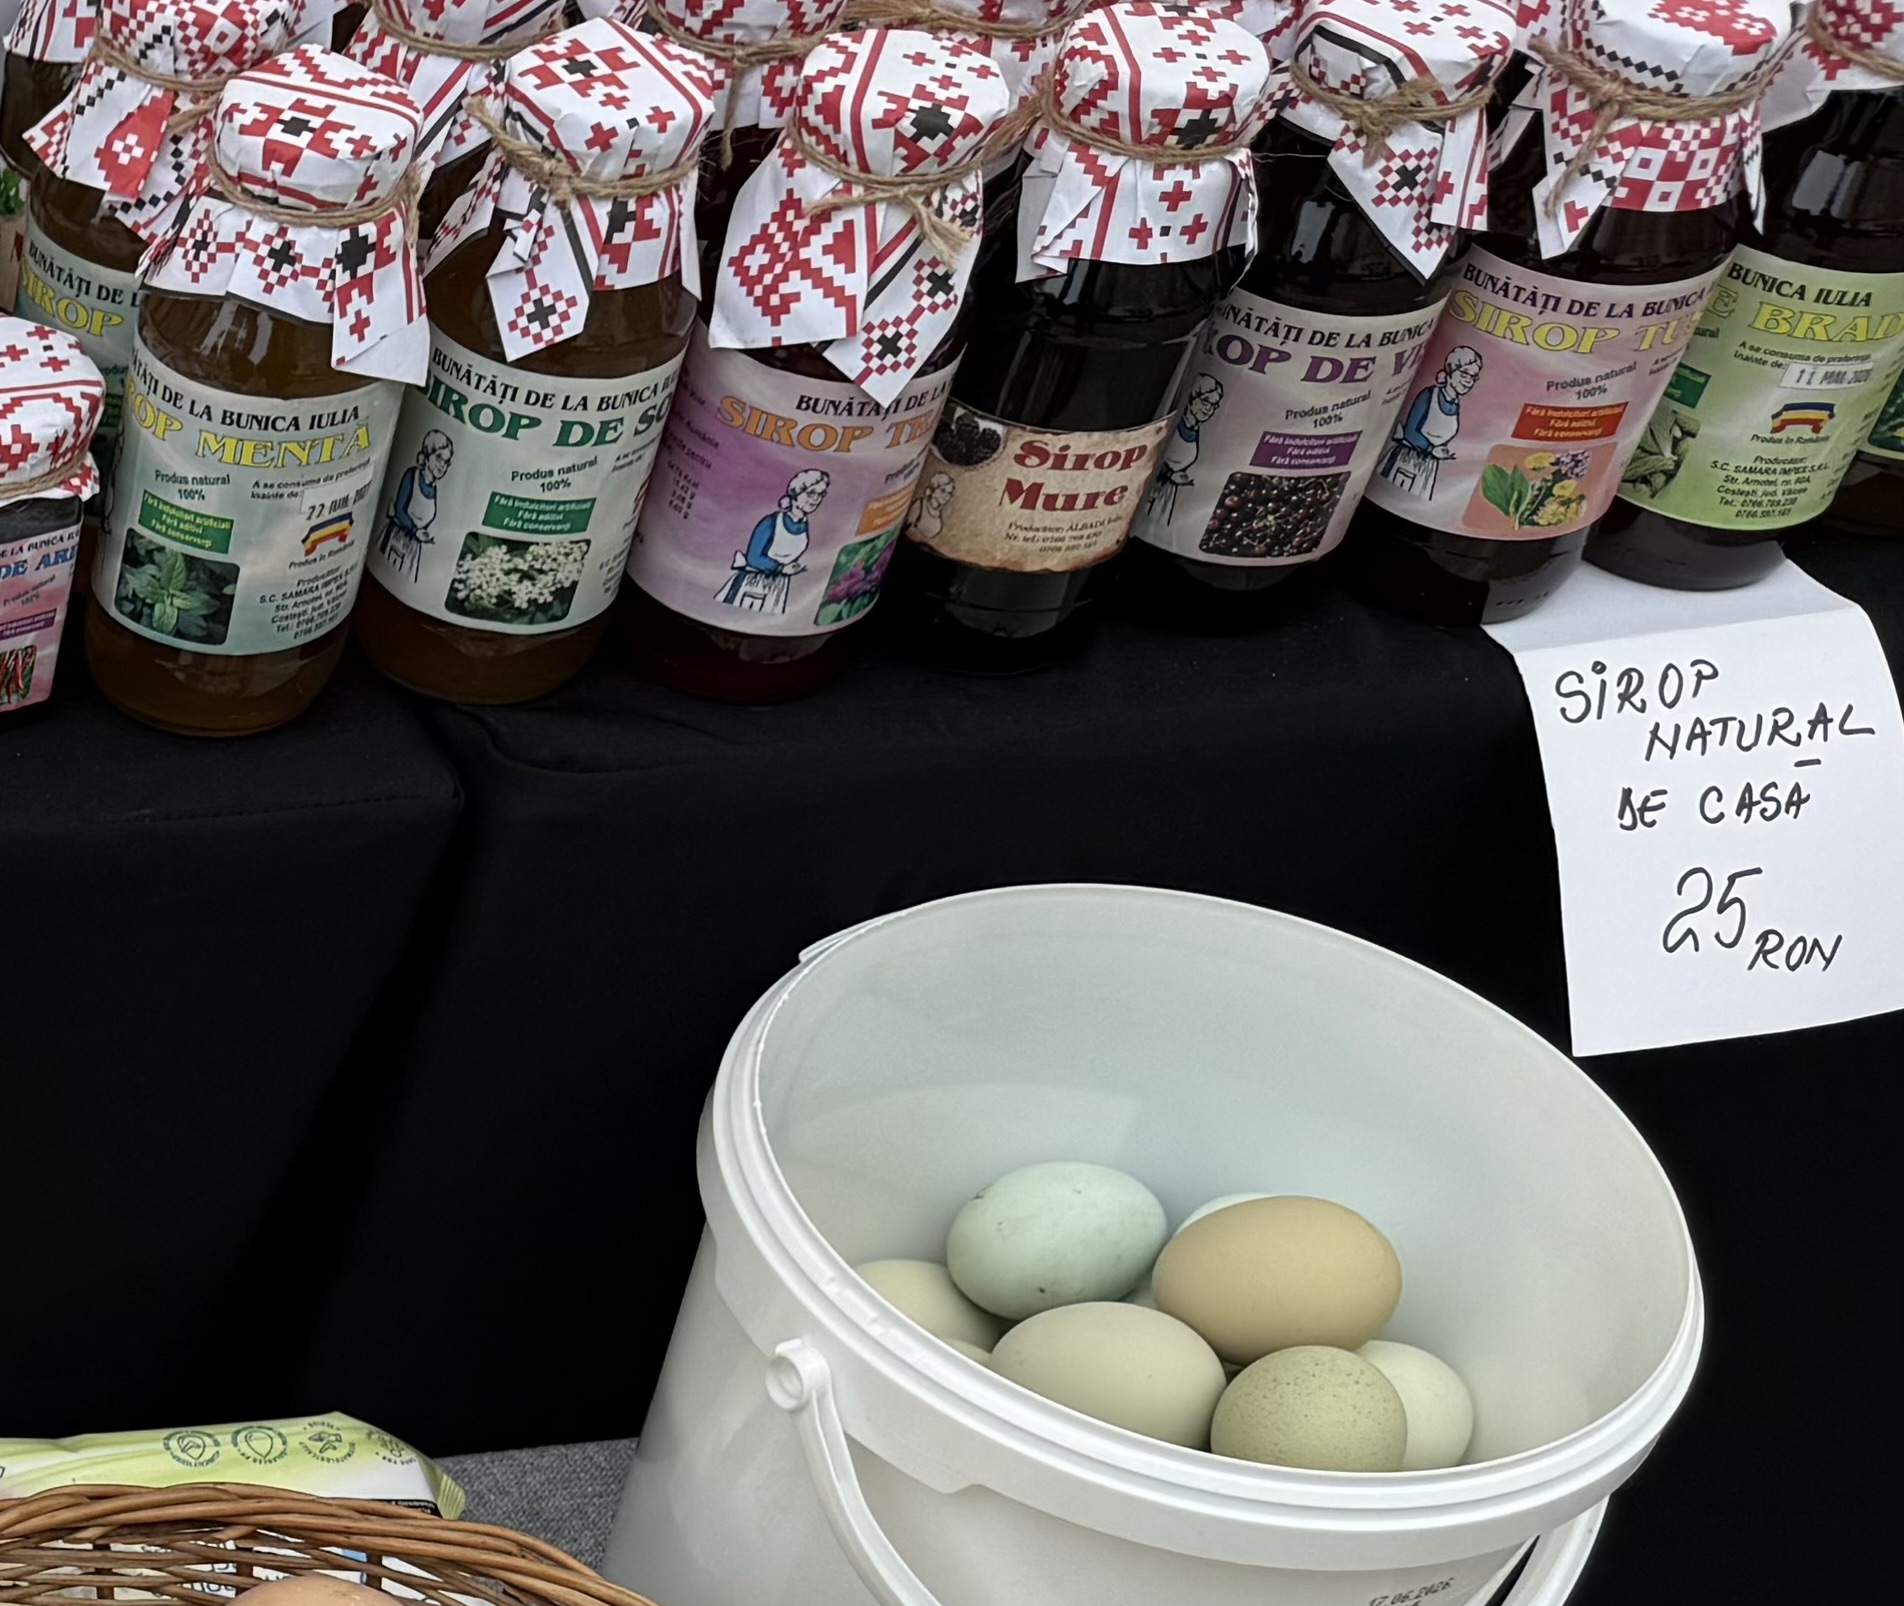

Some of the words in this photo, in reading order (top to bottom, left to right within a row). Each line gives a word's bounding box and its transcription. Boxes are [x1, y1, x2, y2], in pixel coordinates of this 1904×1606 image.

[1461, 262, 1564, 318] BUNĂTĂȚI
[1565, 299, 1602, 318] DE
[1605, 300, 1635, 320] LA
[1727, 260, 1809, 300] BUNICA
[1814, 286, 1873, 308] IULIA
[1449, 288, 1621, 355] SIROP
[430, 346, 520, 406] BUNĂTĂȚI
[523, 387, 556, 409] DE
[559, 393, 589, 412] LA
[596, 382, 661, 413] BUNICA
[1300, 355, 1378, 386] DE
[188, 397, 214, 424] LA
[219, 409, 302, 434] BUNICA
[308, 404, 361, 431] IULIA
[552, 415, 626, 449] DE
[715, 393, 876, 454] SIROP
[193, 413, 372, 470] MENTĂ
[1012, 438, 1149, 473] Sirop
[153, 468, 188, 486] Produs
[188, 471, 232, 487] natural
[510, 464, 556, 484] Produs
[556, 455, 599, 477] natural
[538, 477, 573, 494] 100%
[176, 487, 207, 502] 100%
[998, 476, 1130, 514] Mure
[1644, 702, 1876, 762] NATURAL
[1616, 787, 1669, 831] DE
[1662, 866, 1763, 954] 25
[1747, 927, 1843, 973] RON
